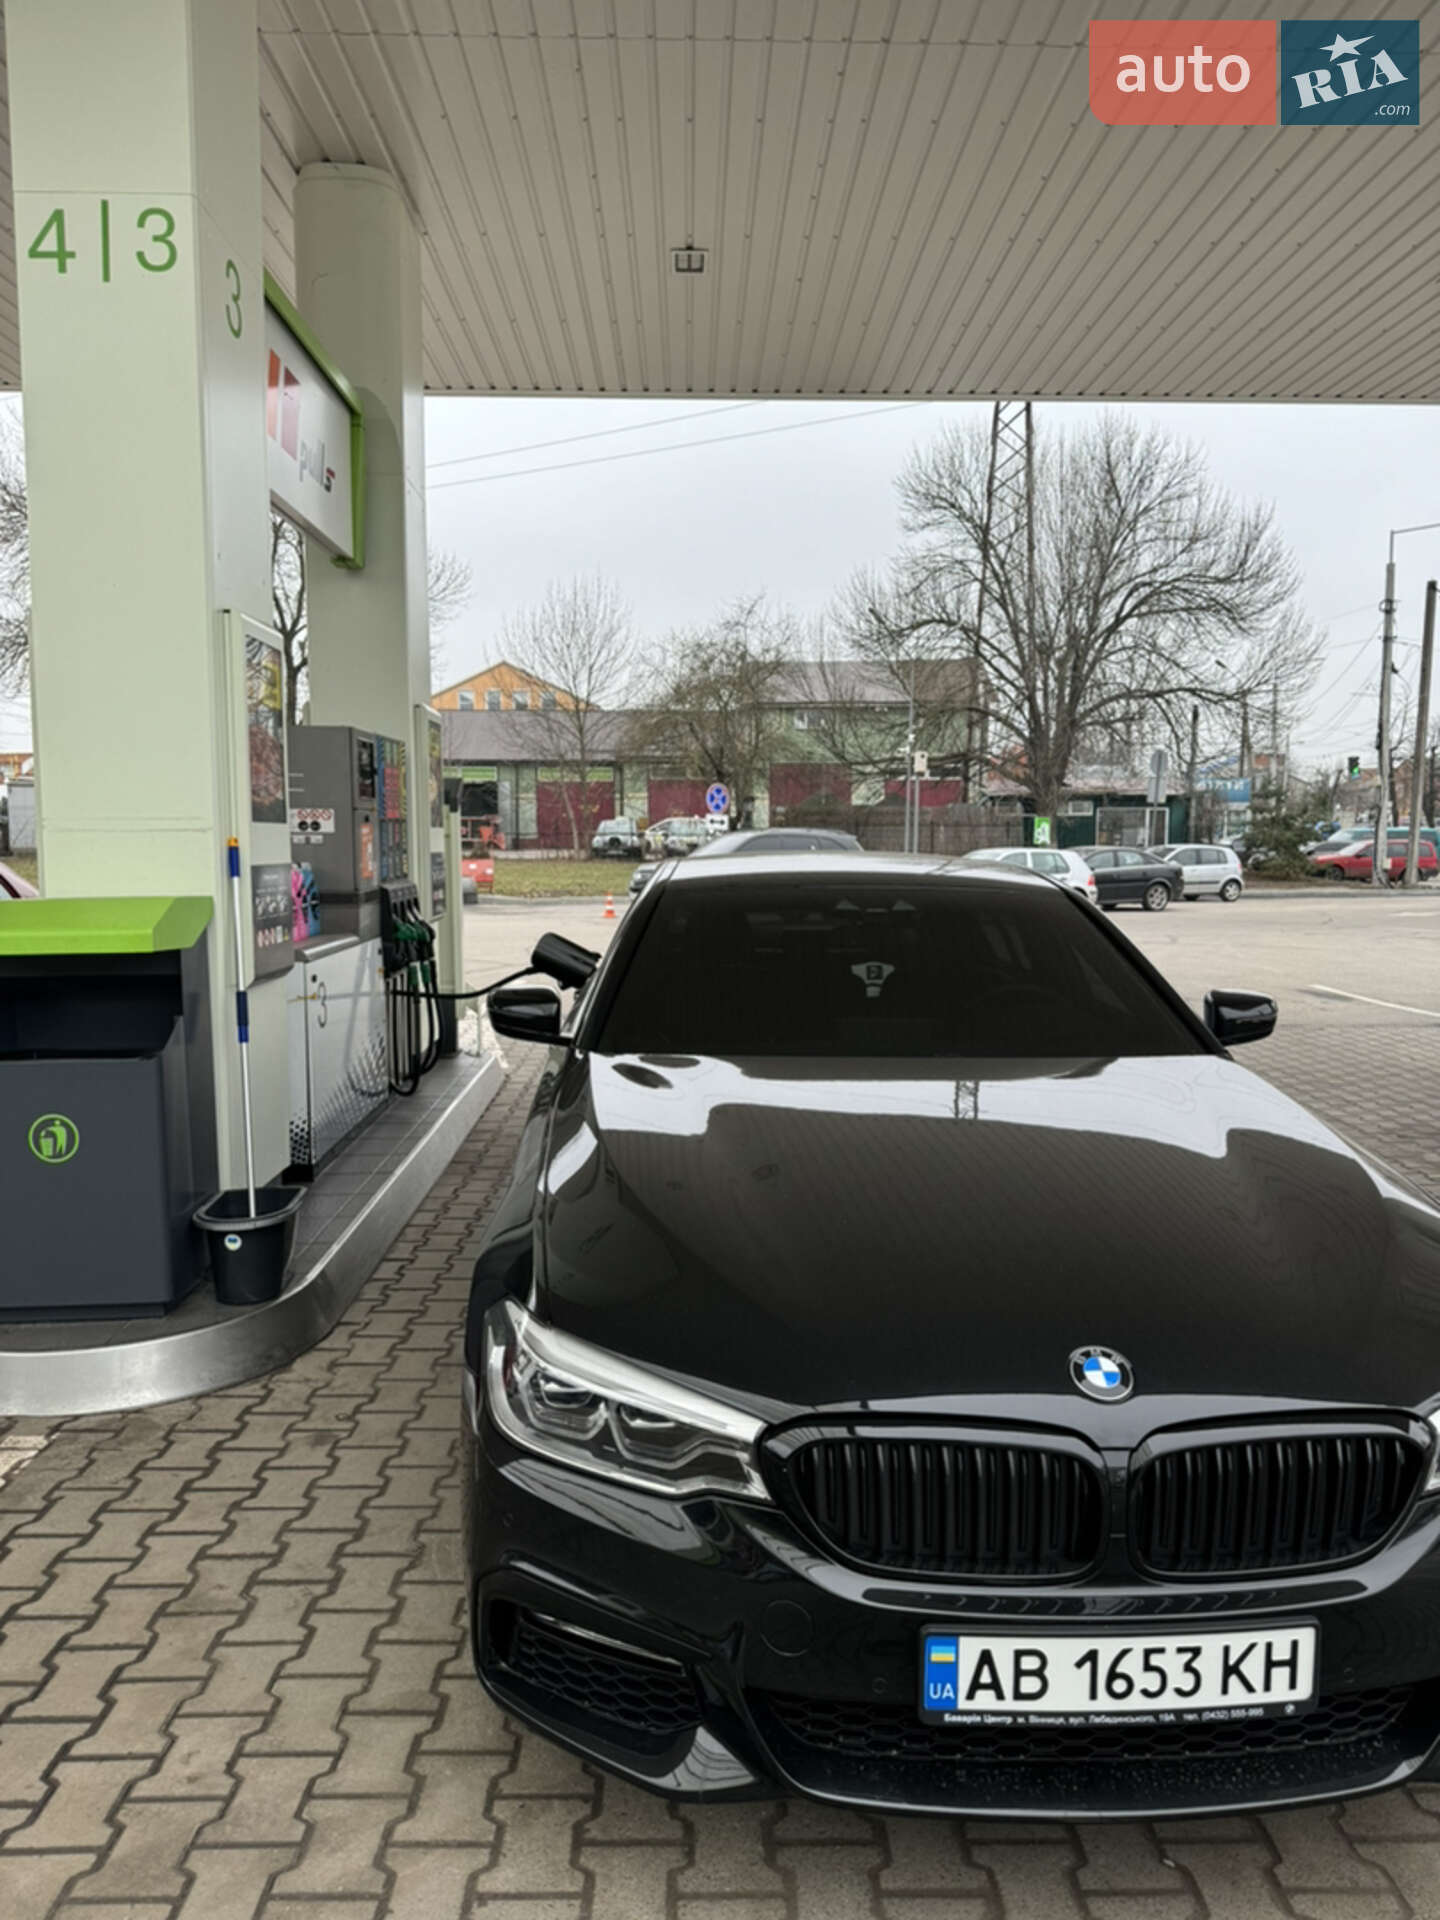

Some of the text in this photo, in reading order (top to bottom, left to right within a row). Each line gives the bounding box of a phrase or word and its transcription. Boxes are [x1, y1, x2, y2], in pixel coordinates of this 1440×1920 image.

[225, 259, 242, 339] 3
[929, 1683, 955, 1700] UA
[965, 1639, 1300, 1701] AB 1653 KH
